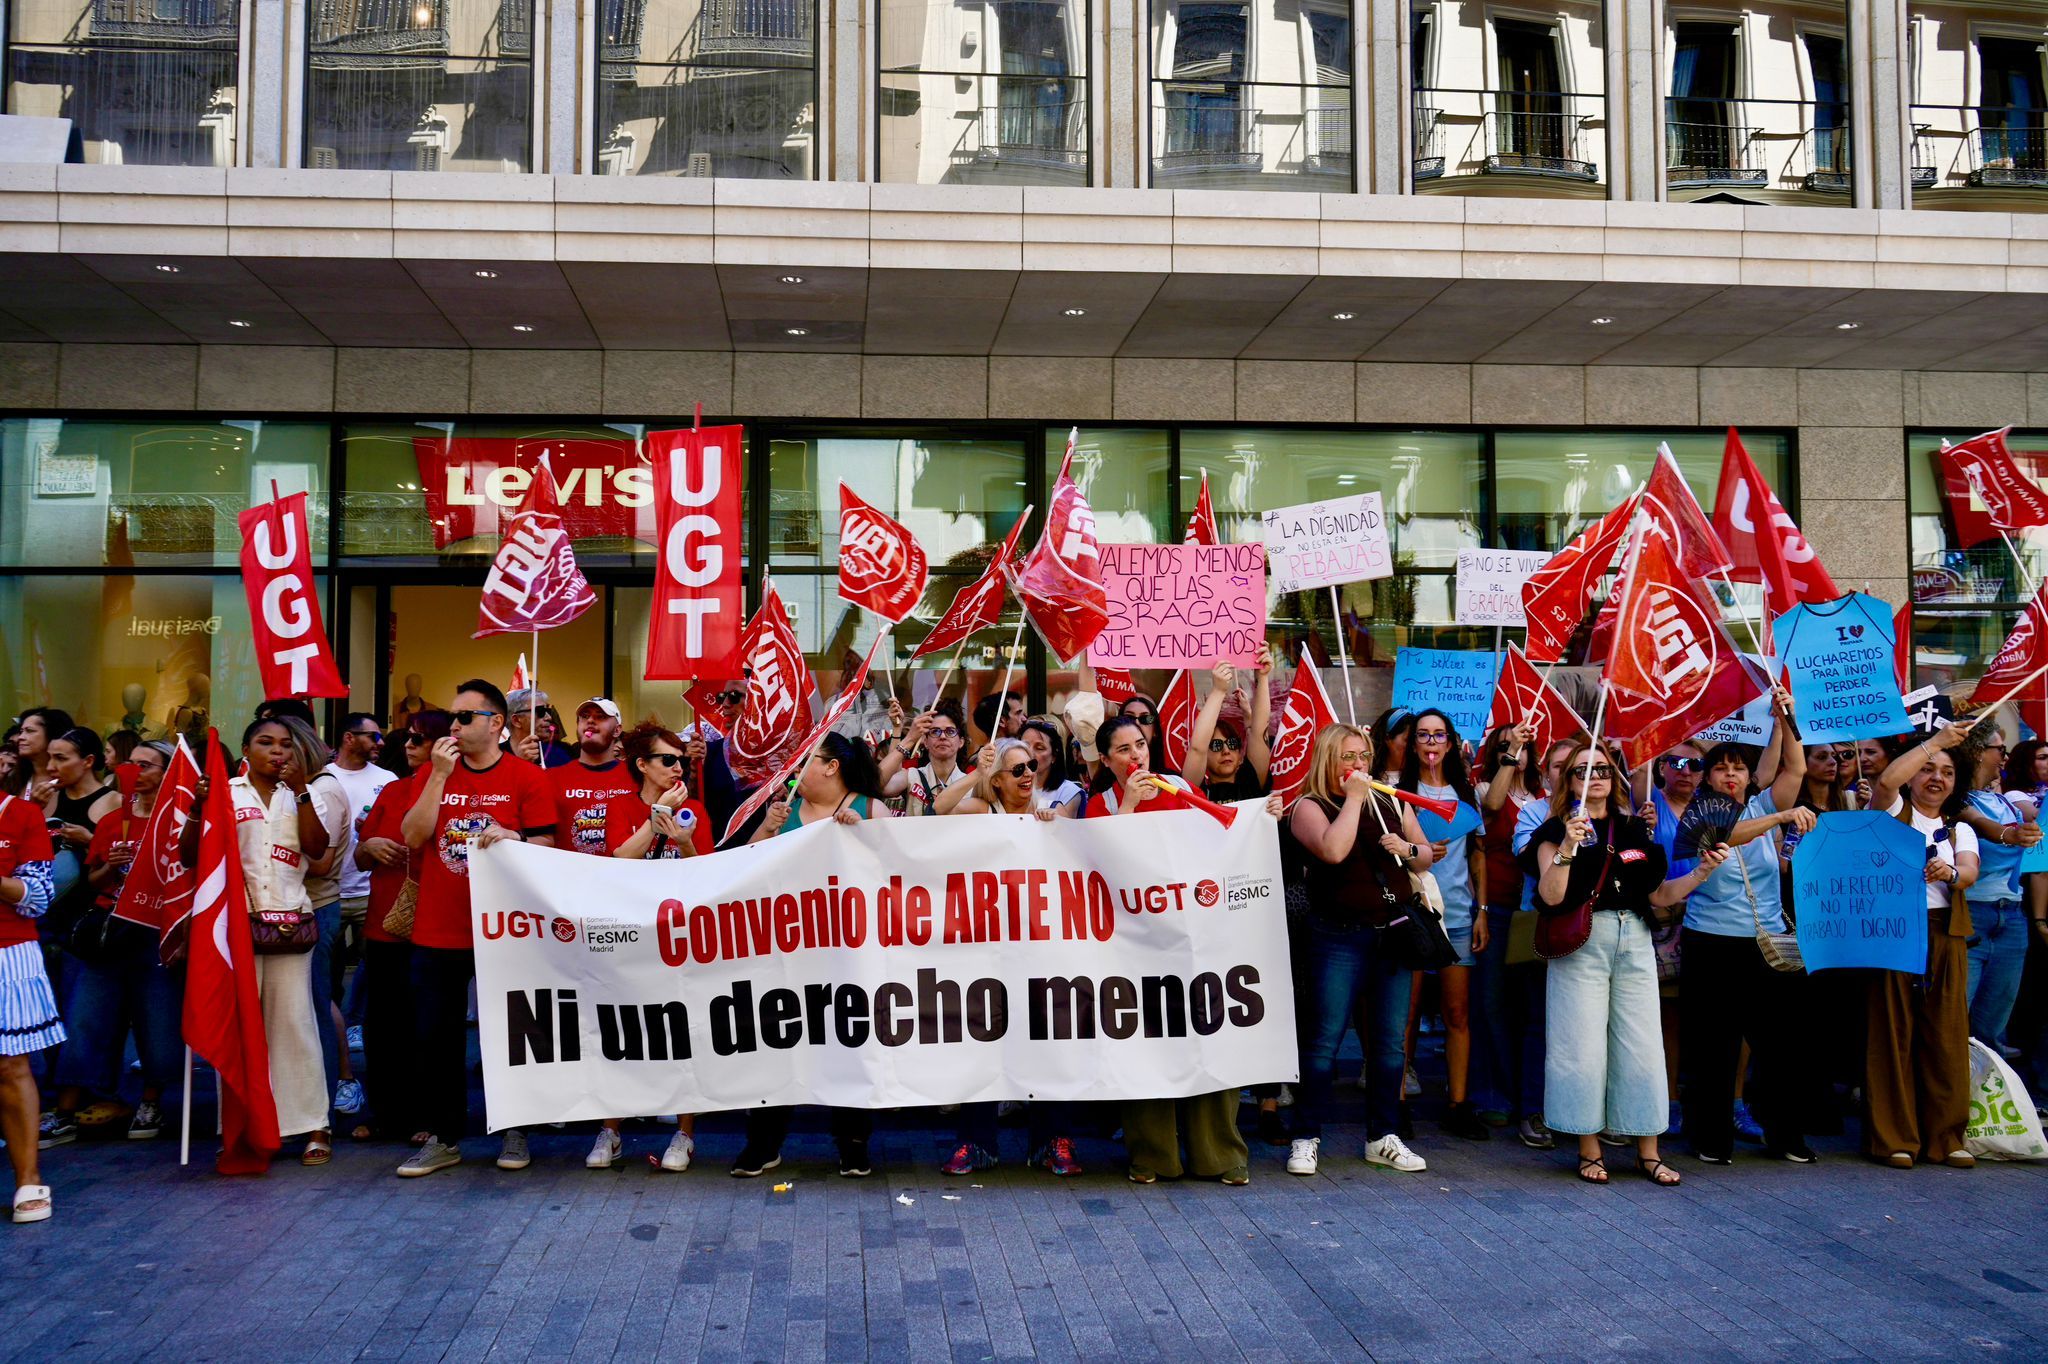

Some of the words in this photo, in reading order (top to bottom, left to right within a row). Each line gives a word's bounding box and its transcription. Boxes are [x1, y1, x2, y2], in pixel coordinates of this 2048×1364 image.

[1281, 521, 1306, 539] LA
[1310, 510, 1380, 537] DIGNIDAD
[841, 514, 900, 568] UGT
[1298, 543, 1310, 552] NO
[1335, 535, 1348, 544] EN
[665, 446, 723, 659] UGT
[1195, 544, 1263, 573] MENOS
[1475, 557, 1493, 572] NO
[1497, 557, 1512, 573] SE
[1518, 557, 1545, 572] VIVE
[1125, 576, 1166, 602] QUE
[1174, 574, 1214, 600] LAS
[1490, 583, 1505, 592] DEL
[254, 512, 319, 695] UGT
[1106, 597, 1257, 631] BRAGAS
[1094, 634, 1136, 658] QUE
[1143, 628, 1257, 659] VENDEMOS
[1796, 647, 1884, 669] LUCHAREMOS
[1434, 675, 1478, 689] VIRAL
[1811, 668, 1839, 679] PARA
[1825, 677, 1871, 693] PERDER
[1813, 692, 1887, 712] NUESTROS
[1809, 712, 1891, 732] DERECHOS
[482, 794, 511, 803] FeSMC
[566, 789, 593, 799] UGT
[236, 811, 251, 820] GT
[271, 846, 292, 861] UGT
[1803, 880, 1819, 899] SIN
[1830, 874, 1904, 895] DERECHOS
[1120, 882, 1187, 915] UGT
[1228, 885, 1270, 903] FeSMC
[1229, 903, 1247, 912] Madrid
[1821, 898, 1840, 914] NO
[1849, 897, 1876, 915] HAY
[261, 912, 286, 921] UGT
[657, 875, 867, 967] Convenio
[877, 875, 932, 948] de
[943, 869, 1051, 944] ARTE
[1058, 870, 1115, 942] NO
[482, 910, 545, 941] UGT
[588, 931, 639, 944] FeSMC
[1861, 917, 1906, 939] DIGNO
[589, 945, 614, 953] Madrid
[506, 988, 581, 1067] Ni
[597, 1001, 693, 1061] un
[709, 967, 1009, 1057] derecho
[1028, 964, 1265, 1041] menos
